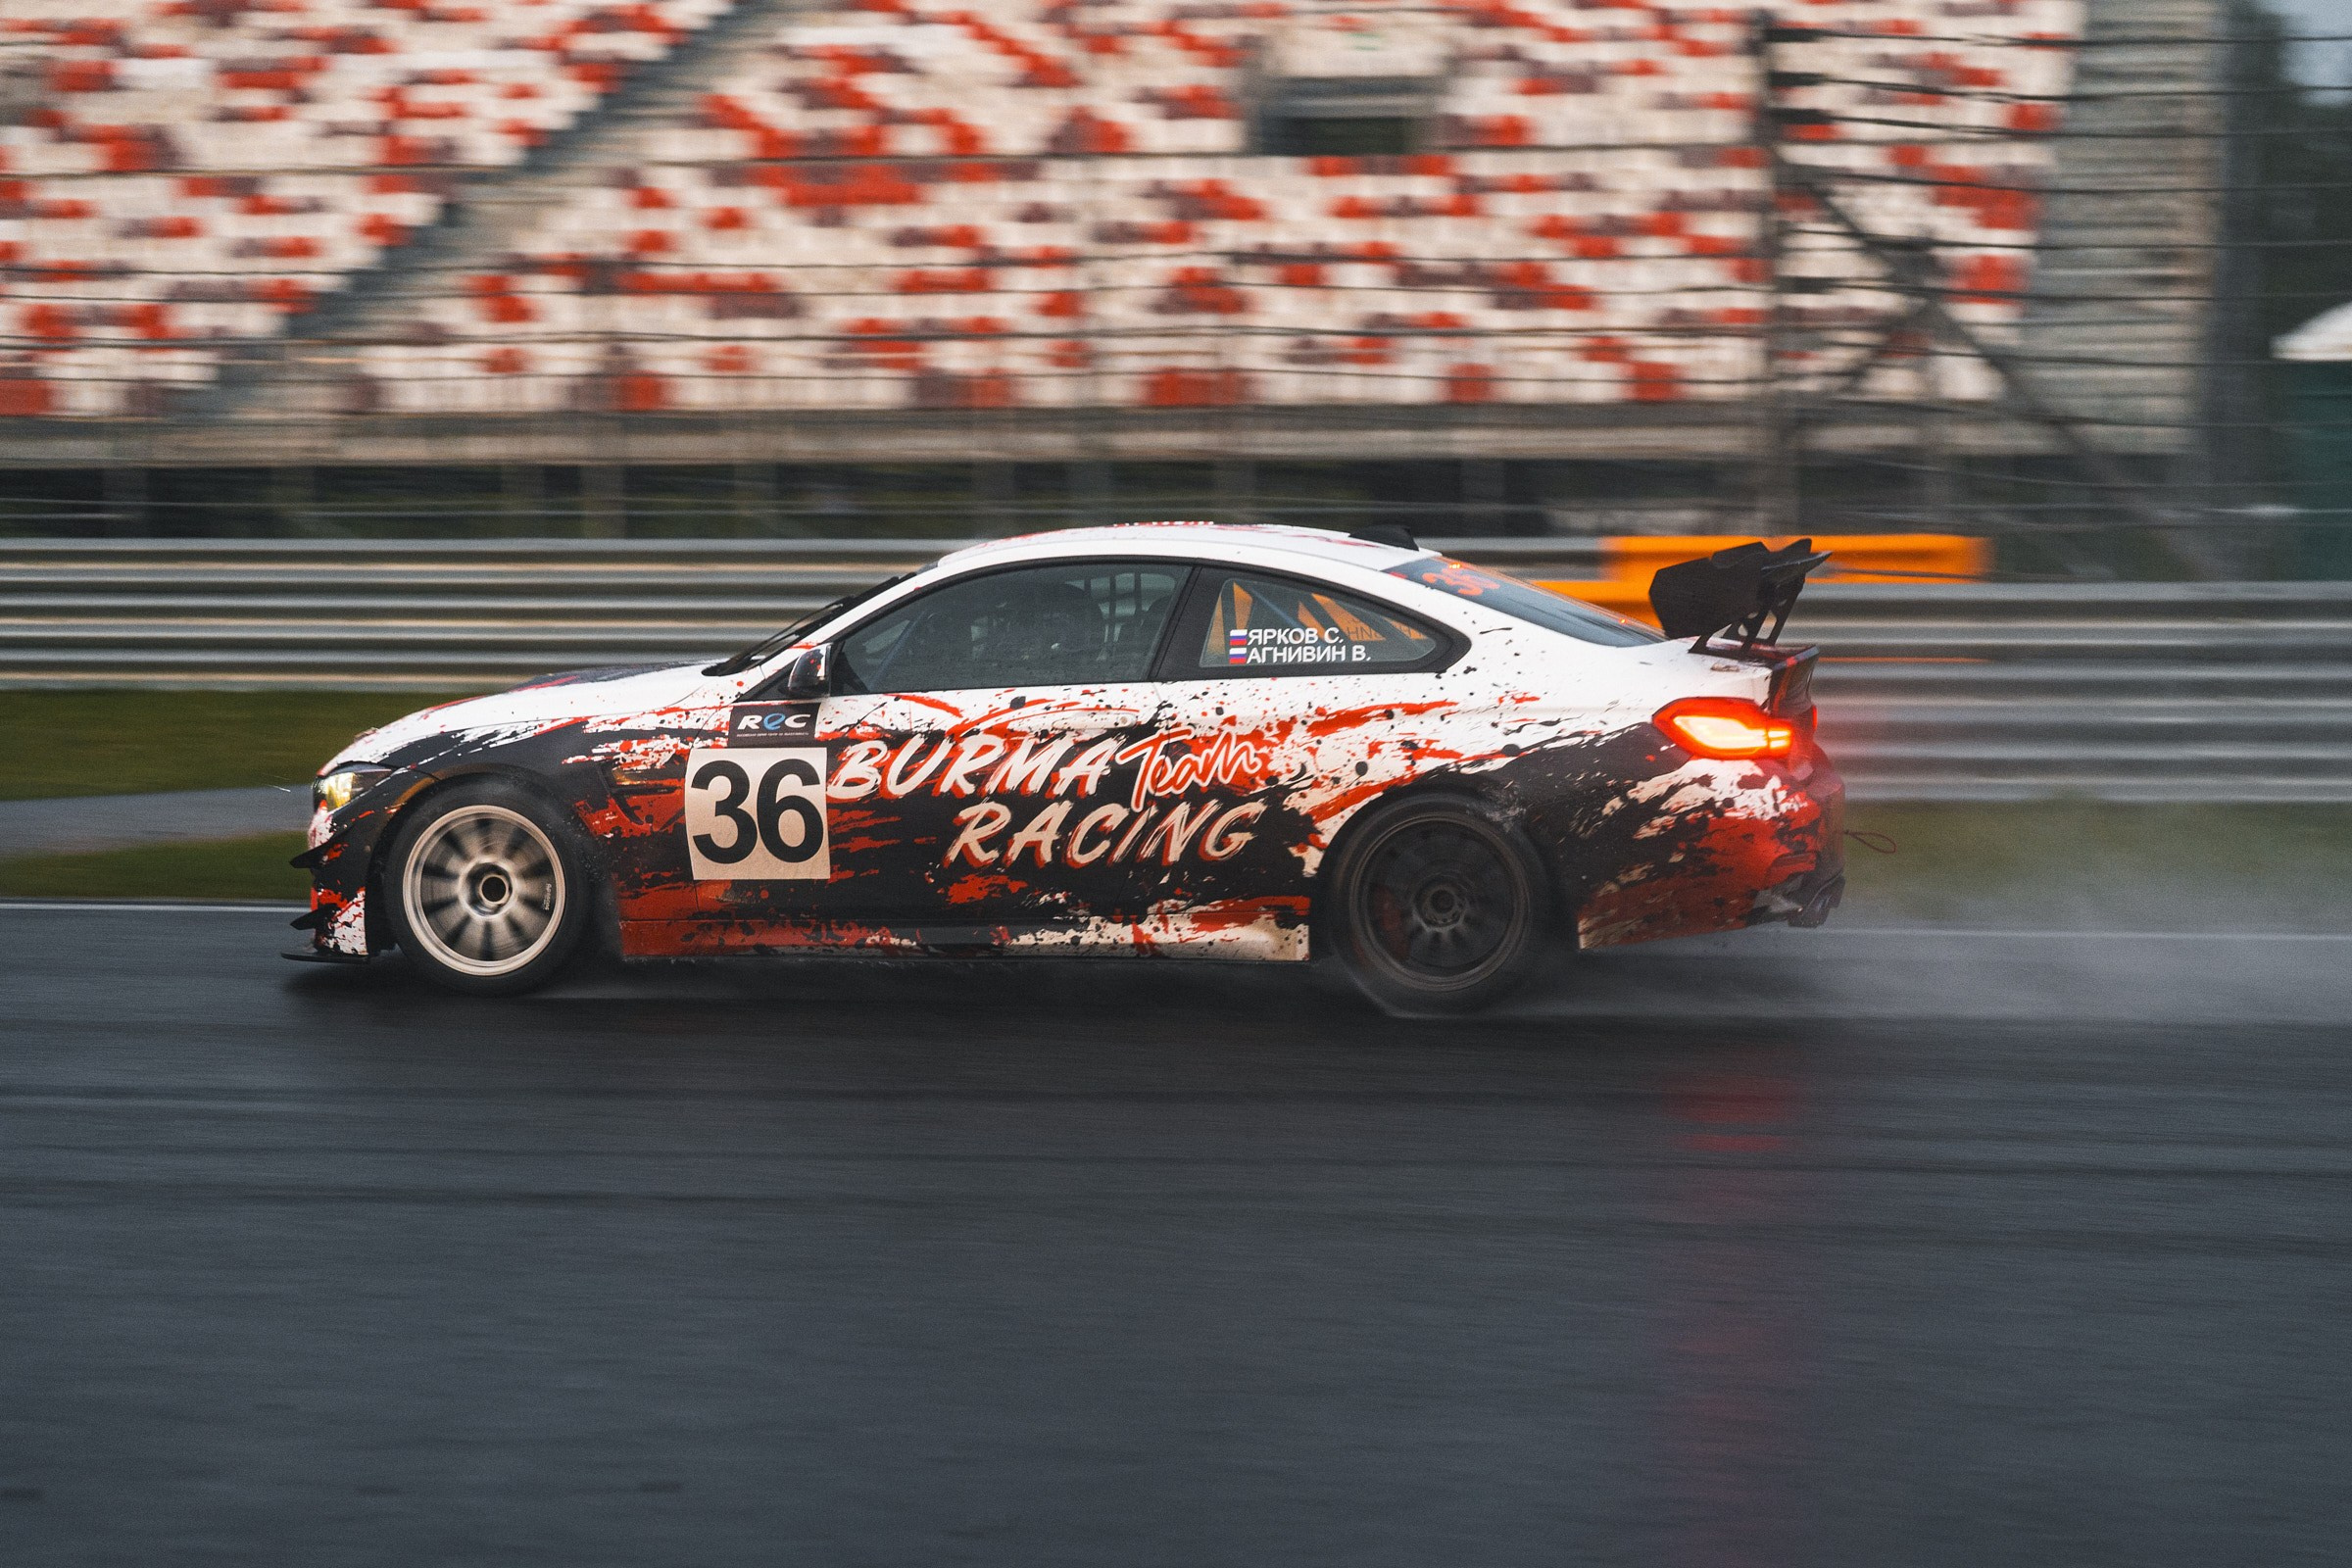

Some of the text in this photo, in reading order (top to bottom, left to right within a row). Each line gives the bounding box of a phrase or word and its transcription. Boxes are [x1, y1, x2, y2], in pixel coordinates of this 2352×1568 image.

[1247, 645, 1346, 664] АГНИВИН
[1248, 628, 1319, 646] ЯРКОВ
[827, 727, 1264, 812] BURMA Team
[691, 758, 824, 864] 36
[945, 798, 1270, 868] RACING
